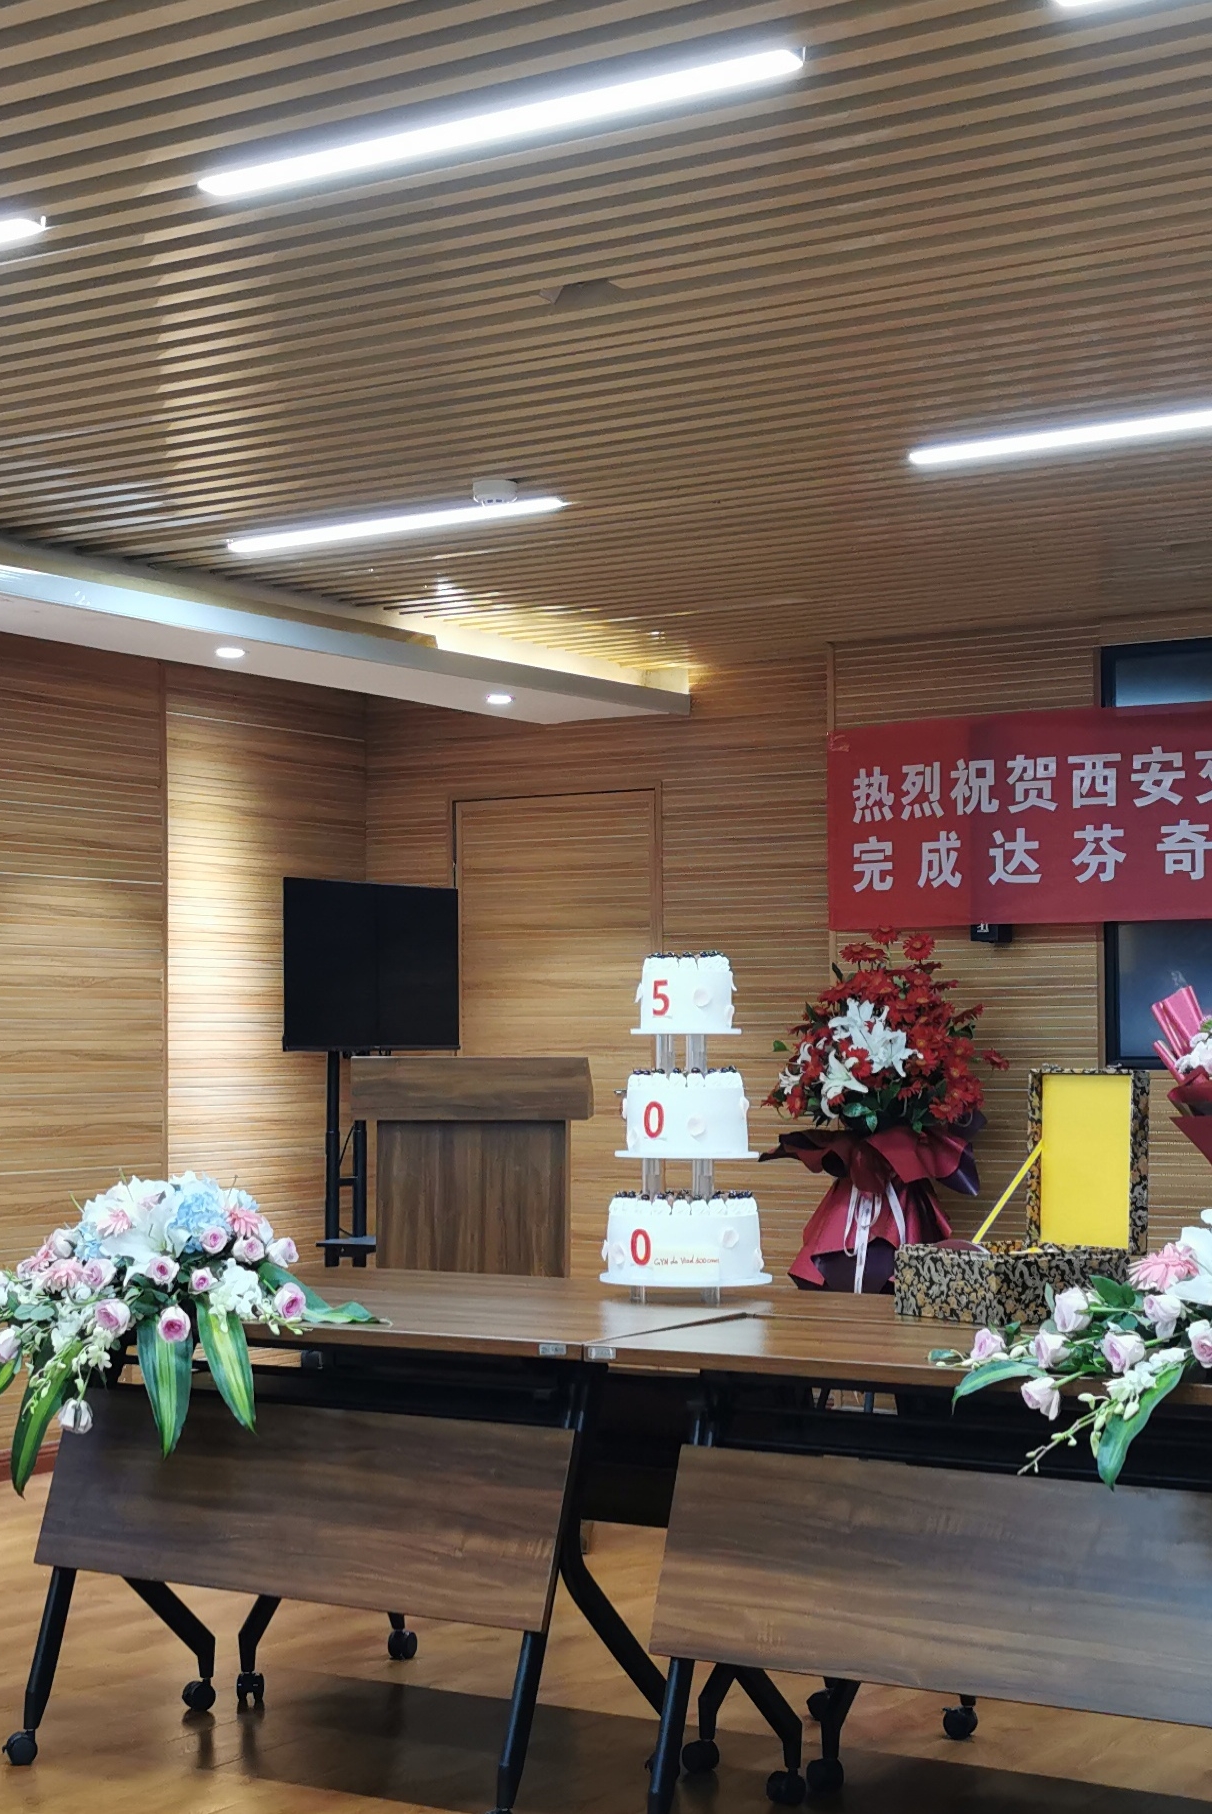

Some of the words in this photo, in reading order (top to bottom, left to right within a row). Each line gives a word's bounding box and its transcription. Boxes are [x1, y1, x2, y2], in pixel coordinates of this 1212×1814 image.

[852, 819, 1212, 892] 完成达芬奇
[652, 979, 670, 1016] 5
[643, 1100, 665, 1139] 0
[630, 1228, 652, 1267] 0
